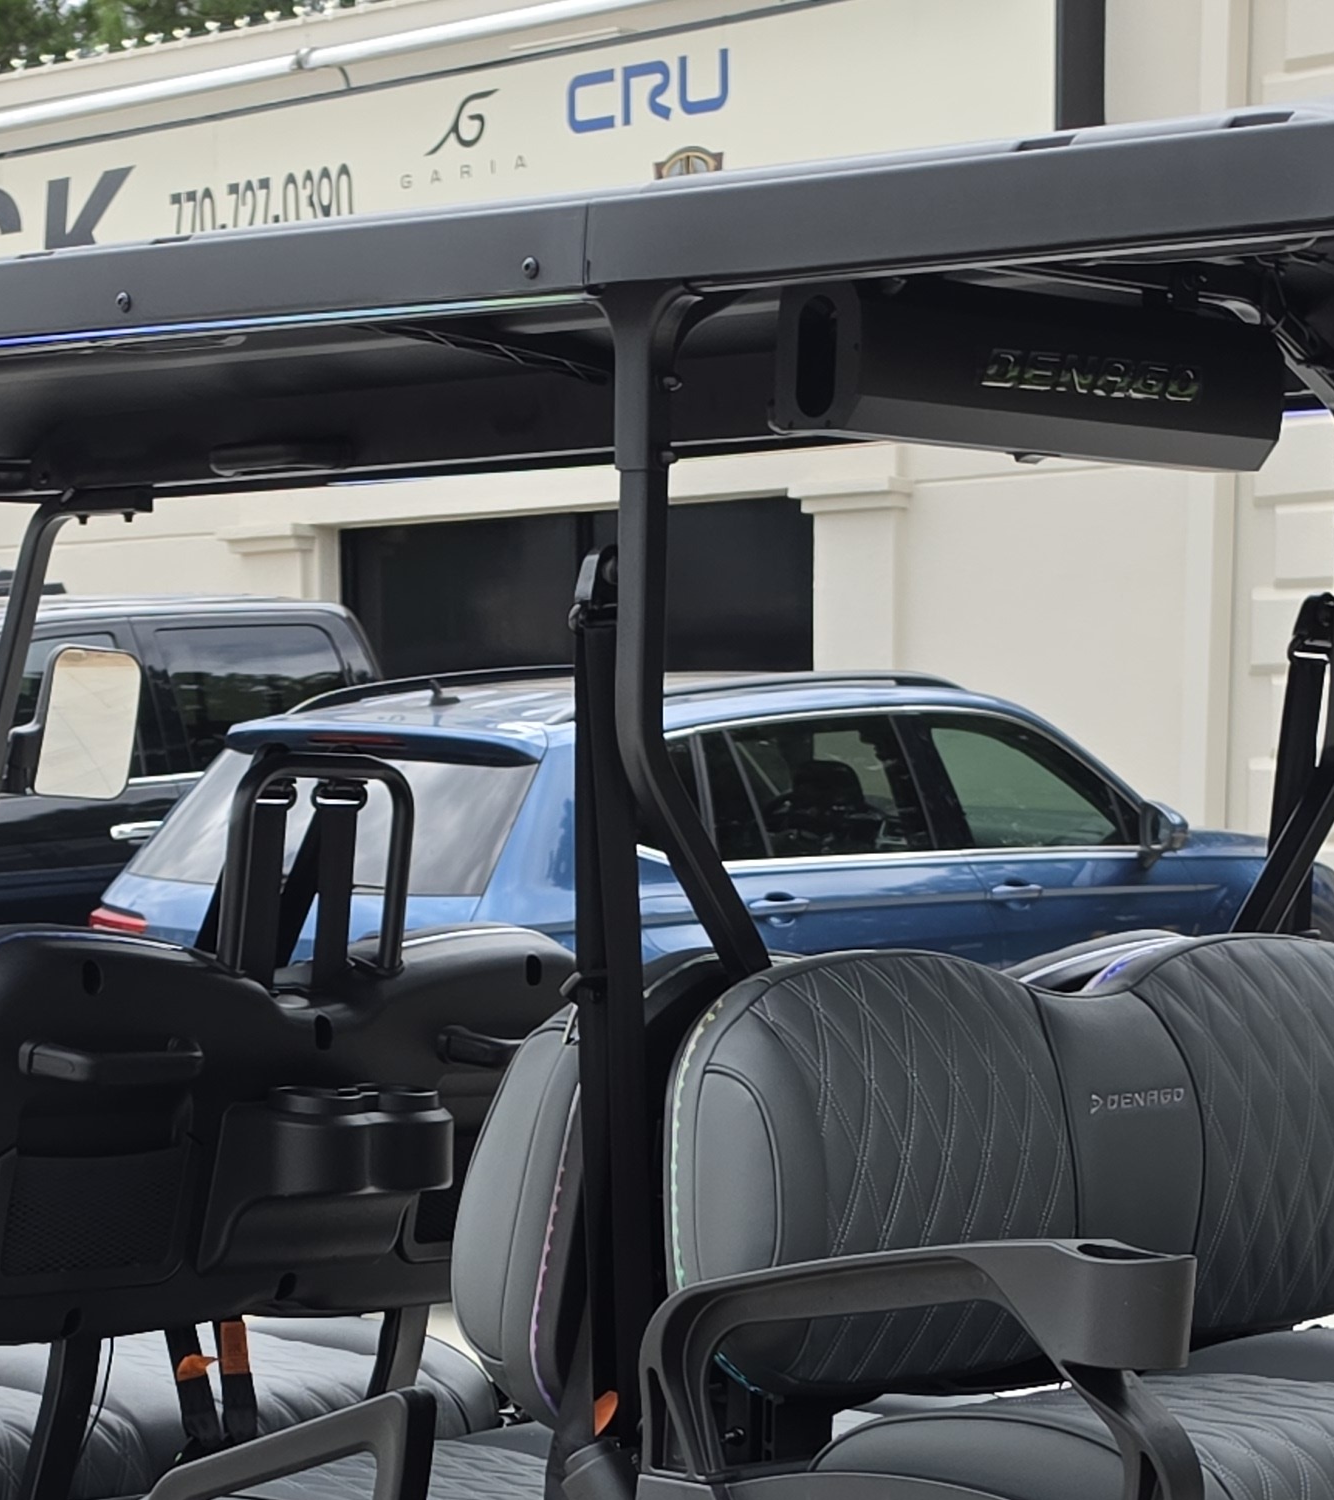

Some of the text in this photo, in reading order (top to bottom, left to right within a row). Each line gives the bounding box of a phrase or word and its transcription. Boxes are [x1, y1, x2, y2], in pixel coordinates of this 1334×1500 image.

[565, 47, 730, 134] CRU
[400, 155, 528, 190] GARIA
[1106, 1087, 1186, 1111] DENAGO
